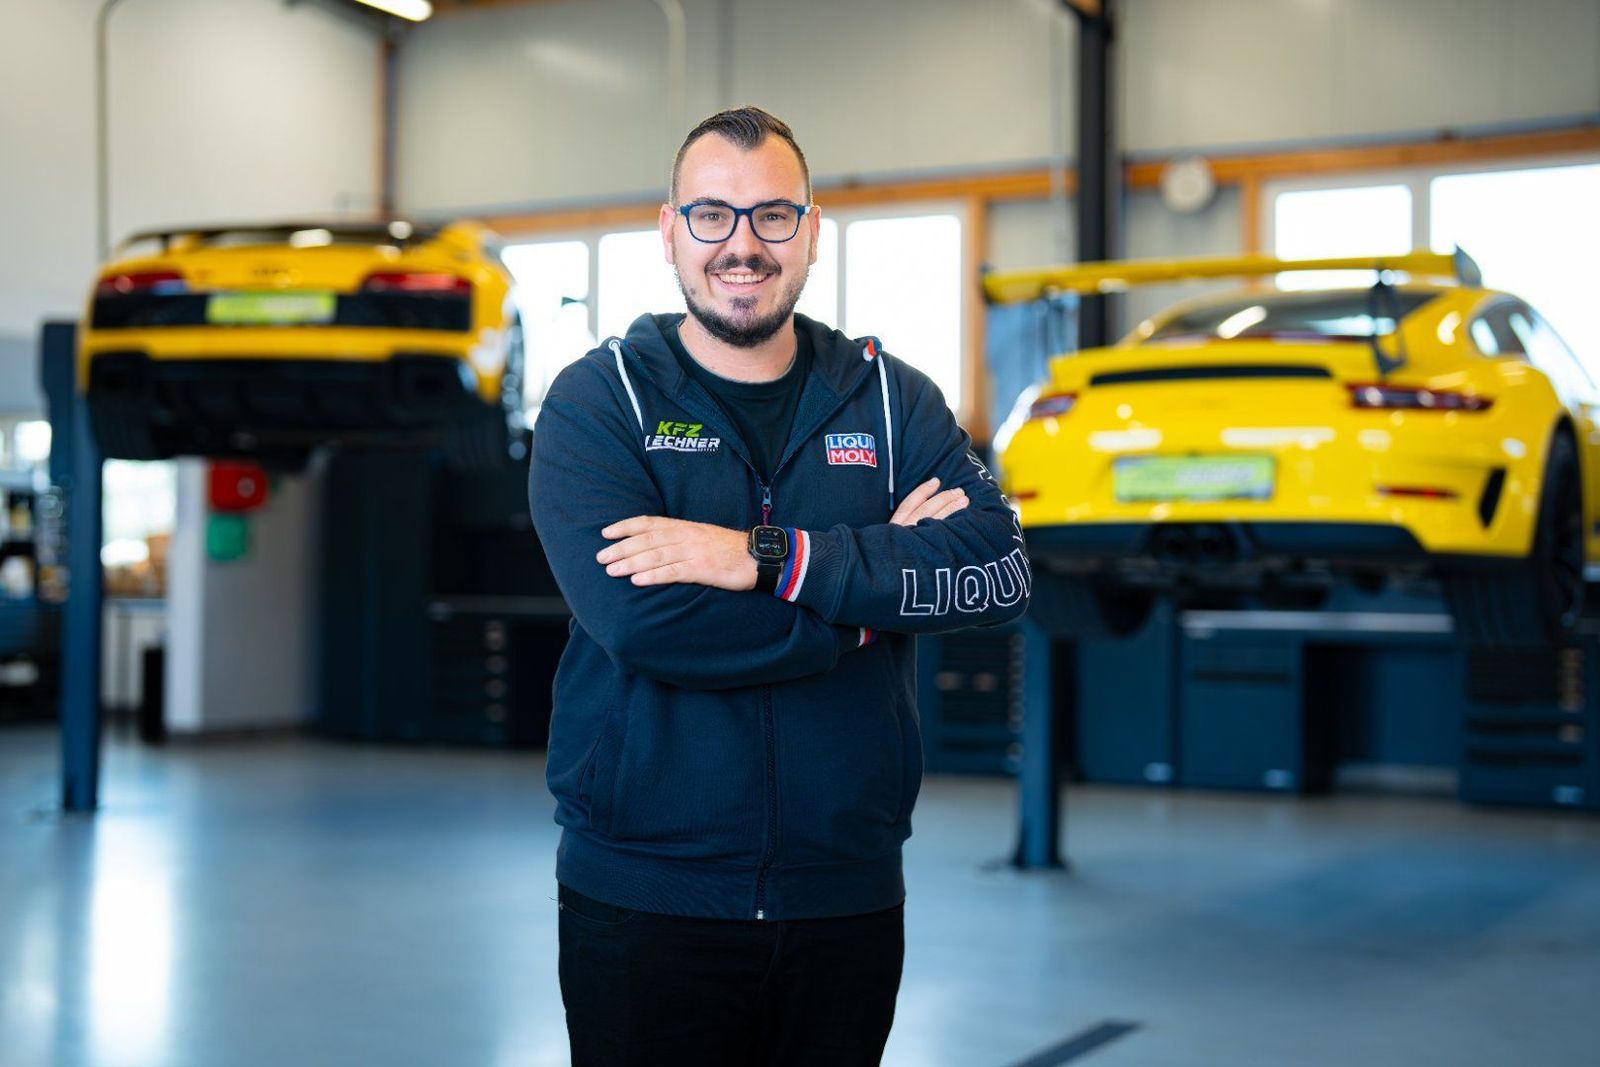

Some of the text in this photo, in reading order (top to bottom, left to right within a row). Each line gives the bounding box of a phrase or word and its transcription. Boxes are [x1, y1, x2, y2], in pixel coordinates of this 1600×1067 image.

[656, 420, 703, 437] KFZ
[644, 434, 721, 452] LECHNER
[828, 435, 873, 450] LIQUI
[830, 449, 874, 464] MOLY
